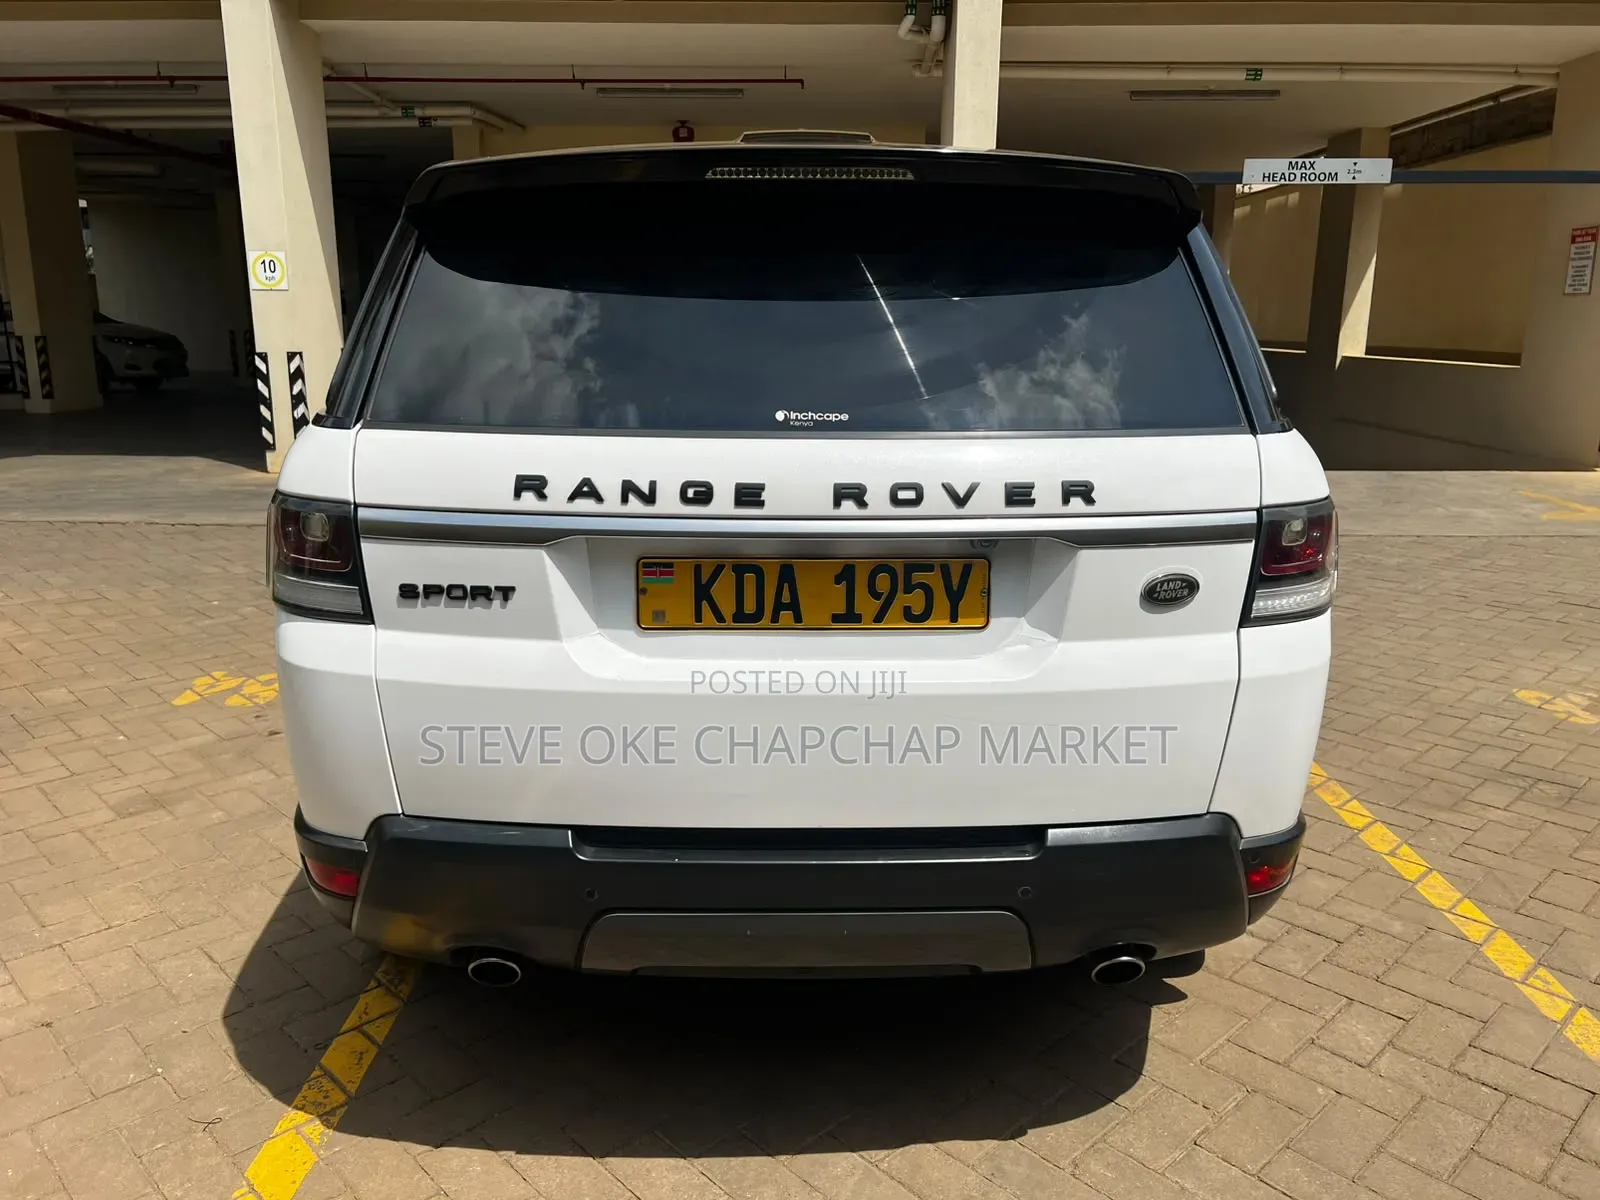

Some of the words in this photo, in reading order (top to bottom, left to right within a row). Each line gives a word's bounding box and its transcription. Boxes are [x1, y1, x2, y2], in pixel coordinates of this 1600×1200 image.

[1287, 160, 1316, 171] MAX
[1262, 172, 1297, 182] HEAD
[1300, 171, 1338, 182] ROOM
[260, 259, 277, 274] 10
[790, 411, 849, 422] Inchcape
[512, 473, 766, 510] RANGE
[832, 480, 1097, 510] ROVER
[1156, 580, 1182, 591] LAND
[398, 583, 517, 602] SPORT
[693, 563, 803, 624] KDA
[831, 563, 973, 624] 195Y
[1158, 588, 1189, 600] ROVER
